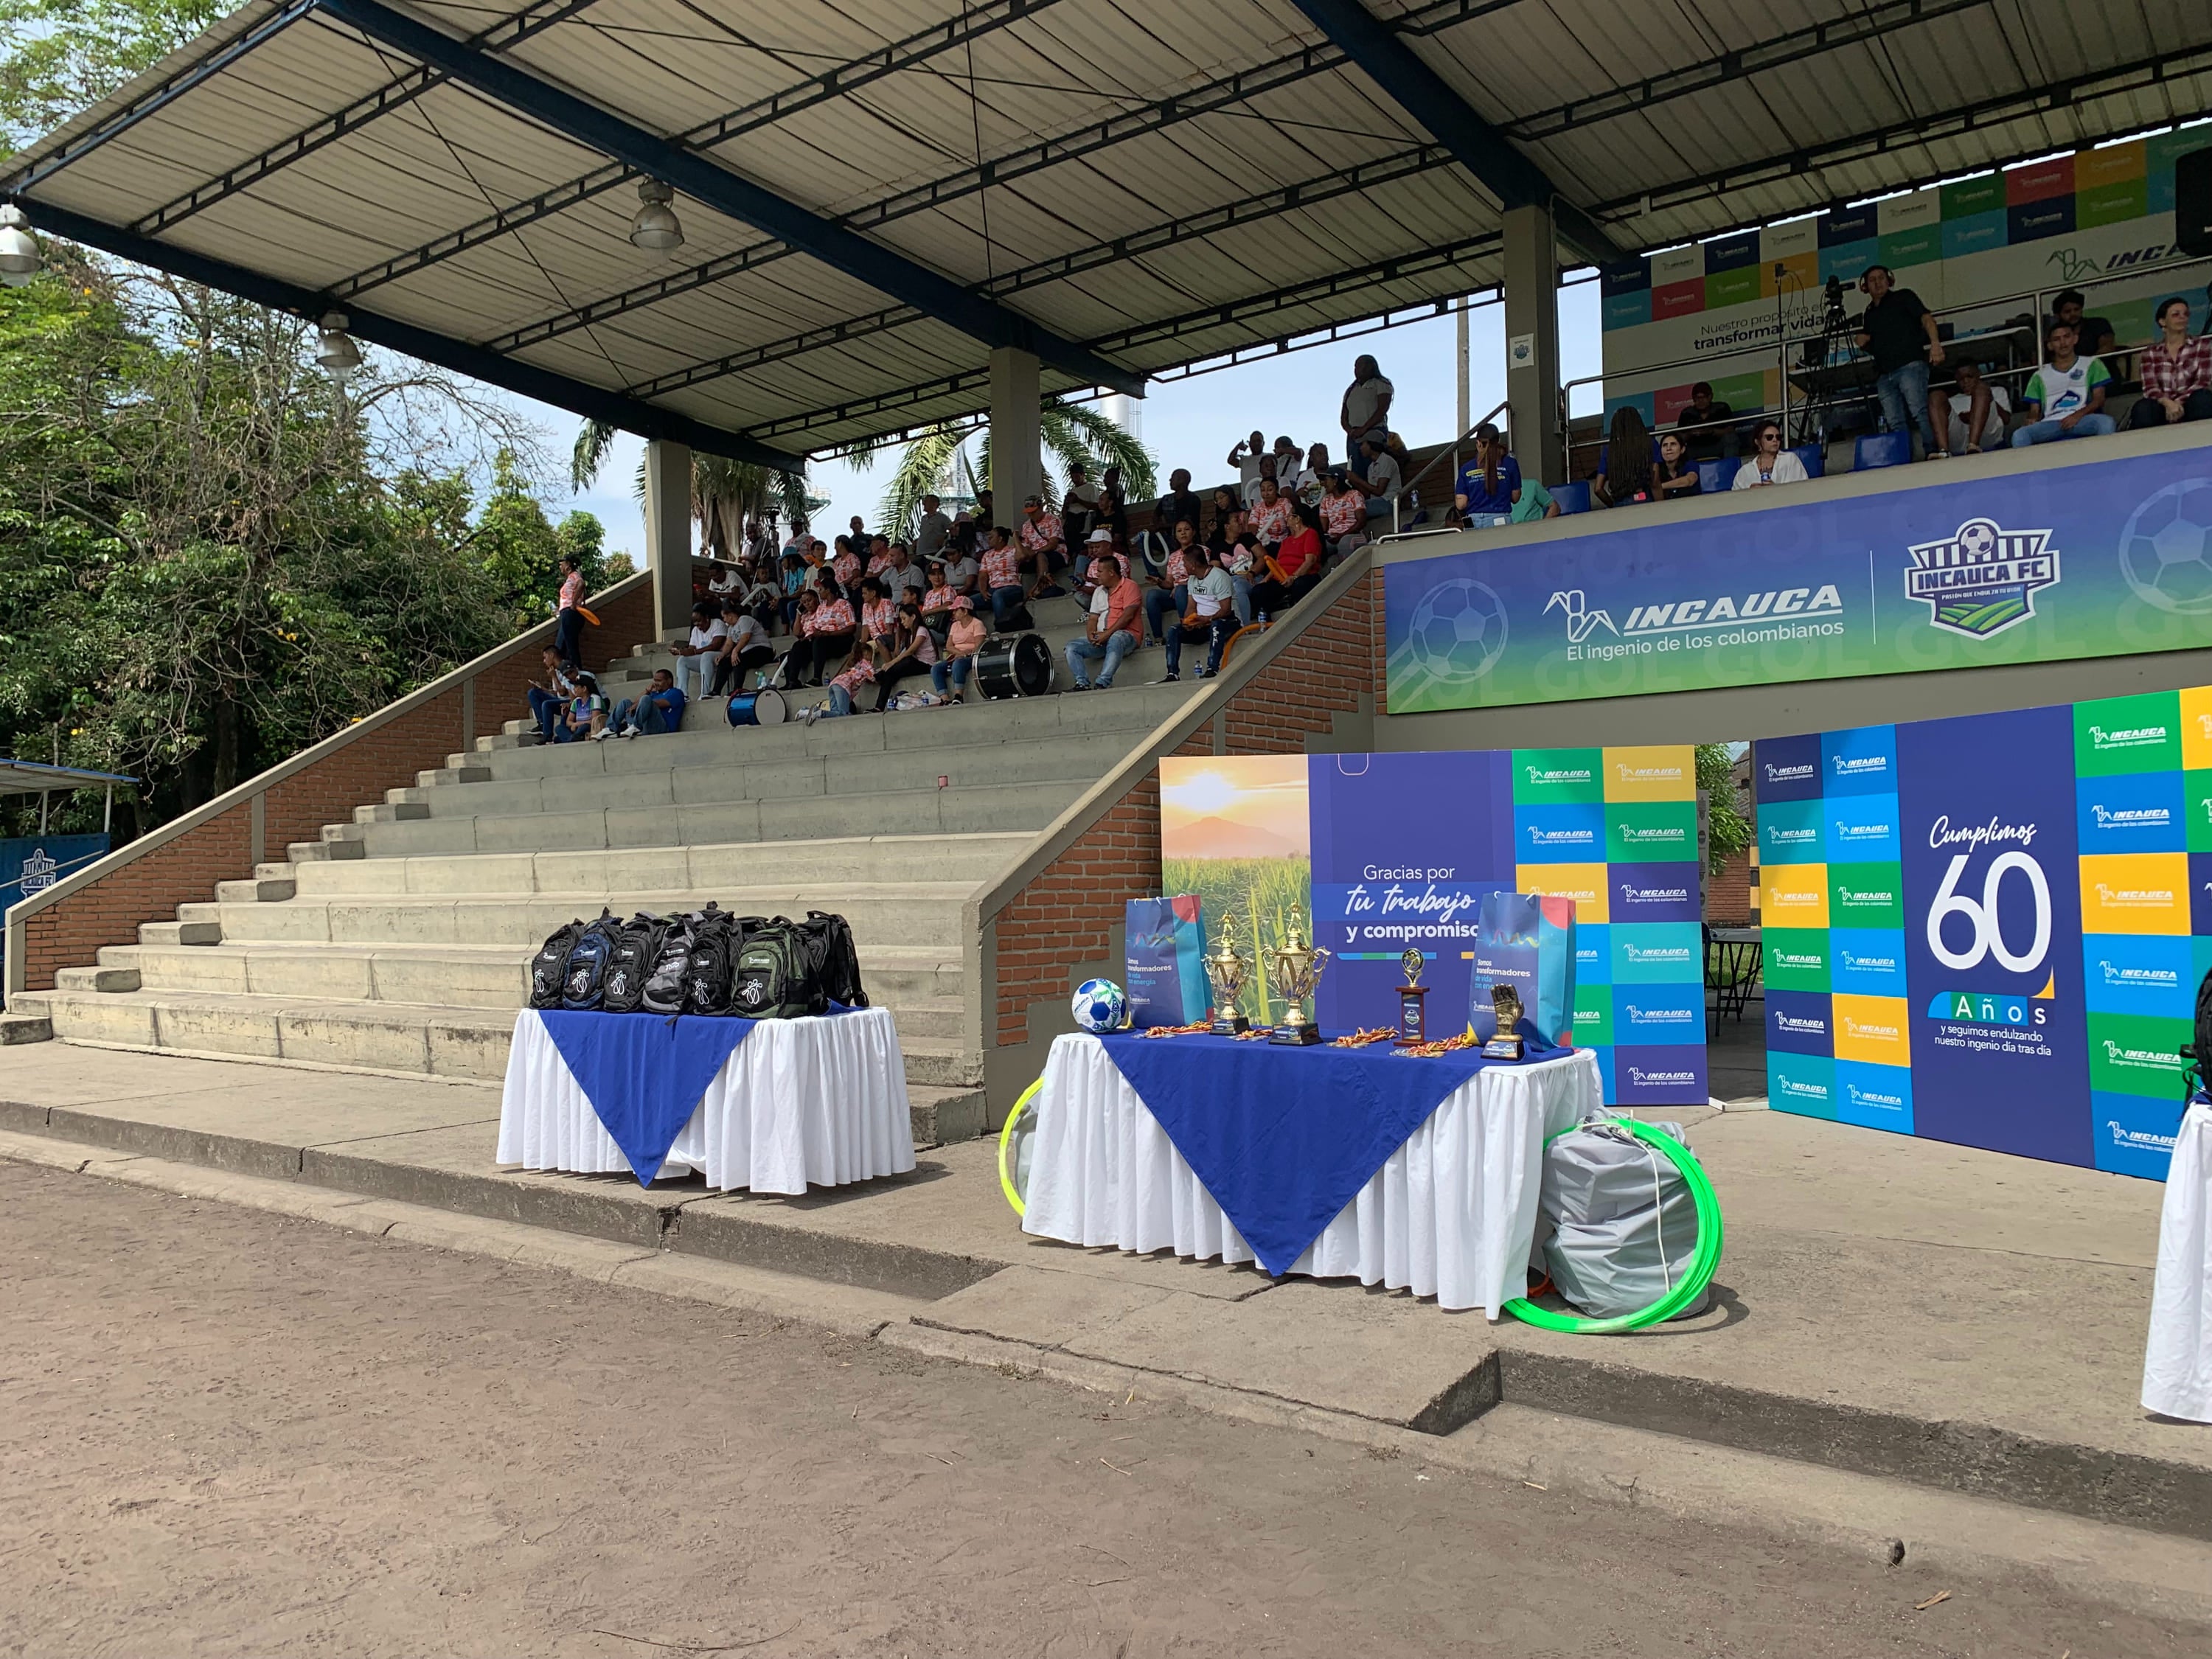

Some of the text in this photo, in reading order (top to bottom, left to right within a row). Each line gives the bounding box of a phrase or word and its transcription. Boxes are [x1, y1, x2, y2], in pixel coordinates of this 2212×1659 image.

[1701, 319, 1747, 335] Nuestro
[1918, 558, 2045, 591] INCAUCA FC
[1624, 584, 1843, 630] INCAUCA
[1567, 620, 1844, 662] El ingenio de los colombianos
[2110, 727, 2166, 739] INCAUCA
[1847, 756, 1886, 766] INCAUCA
[1778, 765, 1813, 773] INCAUCA
[2113, 809, 2169, 819] INCAUCA
[1781, 829, 1816, 837] INCAUCA
[1851, 824, 1889, 832] INCAUCA
[1930, 815, 2036, 852] Cumplimos
[1364, 865, 1455, 884] Gracias por
[2117, 891, 2173, 899] INCAUCA
[1345, 883, 1475, 923] tu trabajo
[1927, 851, 2052, 973] 60
[1346, 926, 1358, 943] y
[1856, 957, 1895, 965] INCAUCA
[1476, 967, 1531, 977] transformadores
[2121, 969, 2177, 978] INCAUCA
[1955, 995, 2046, 1025] Años
[1789, 1018, 1824, 1027] INCAUCA
[1941, 1025, 2043, 1043] y seguimos endulzando
[1935, 1036, 2051, 1056] nuestro ingenio día tras día
[2124, 1049, 2182, 1062] INCAUCA
[1792, 1082, 1827, 1093] INCAUCA
[1863, 1092, 1902, 1104] INCAUCA
[2129, 1131, 2177, 1146] INCAUC
